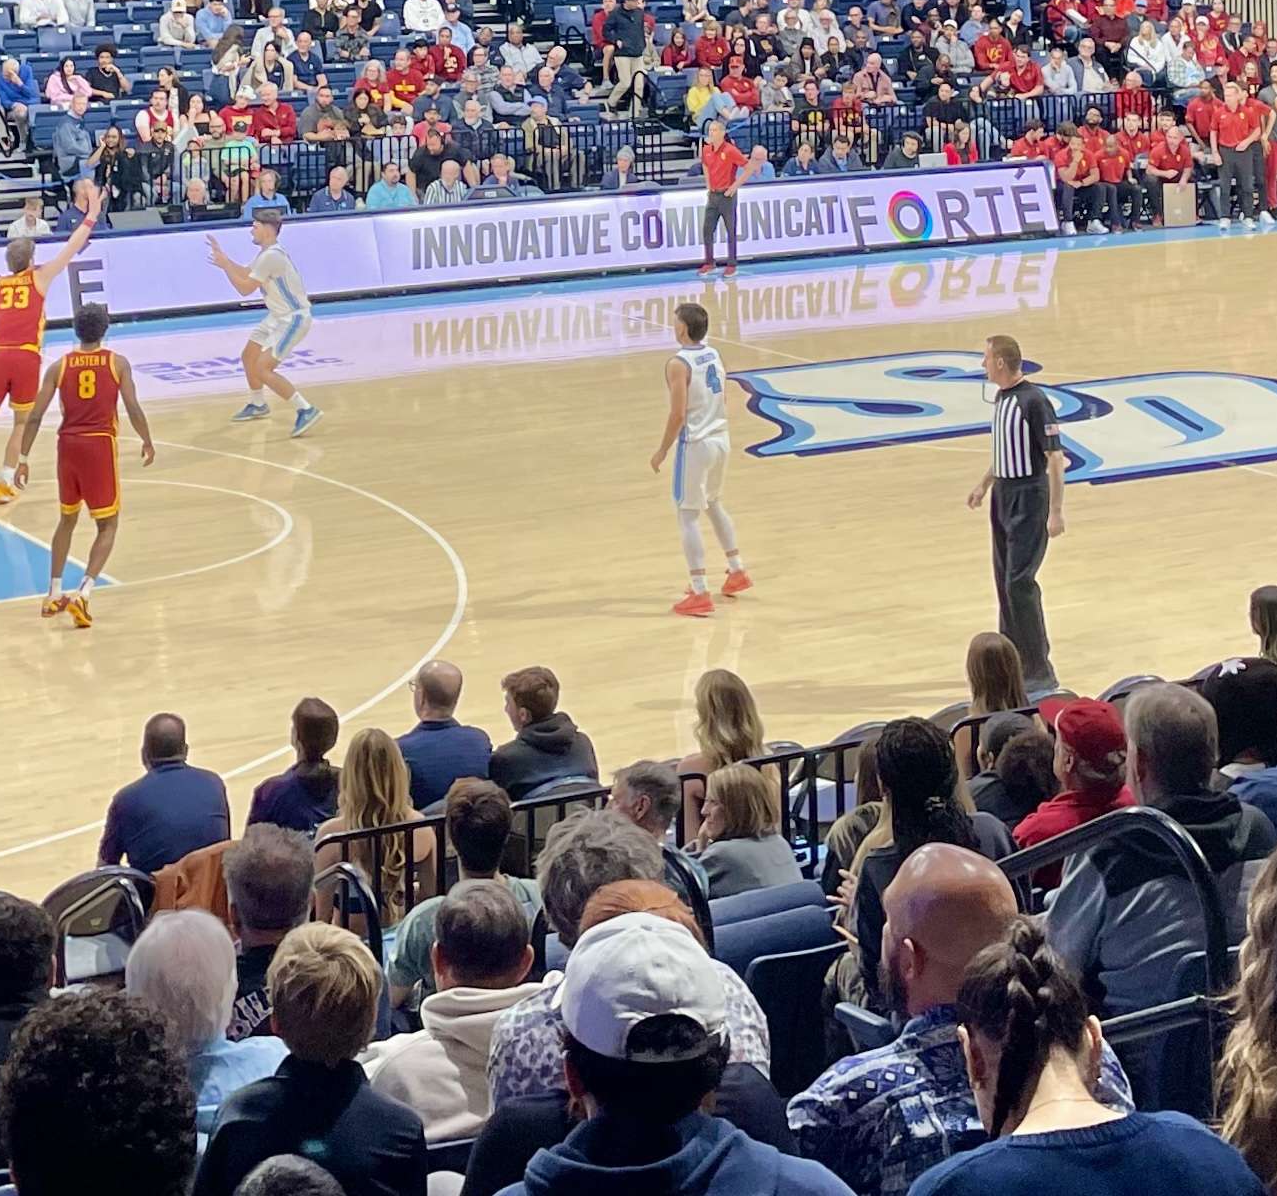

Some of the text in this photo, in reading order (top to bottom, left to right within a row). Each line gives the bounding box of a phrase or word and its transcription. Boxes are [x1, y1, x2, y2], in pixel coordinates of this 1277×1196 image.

[412, 212, 611, 270] INNOVATIVE
[0, 285, 30, 310] 33
[78, 370, 97, 400] 8
[706, 363, 723, 394] 4
